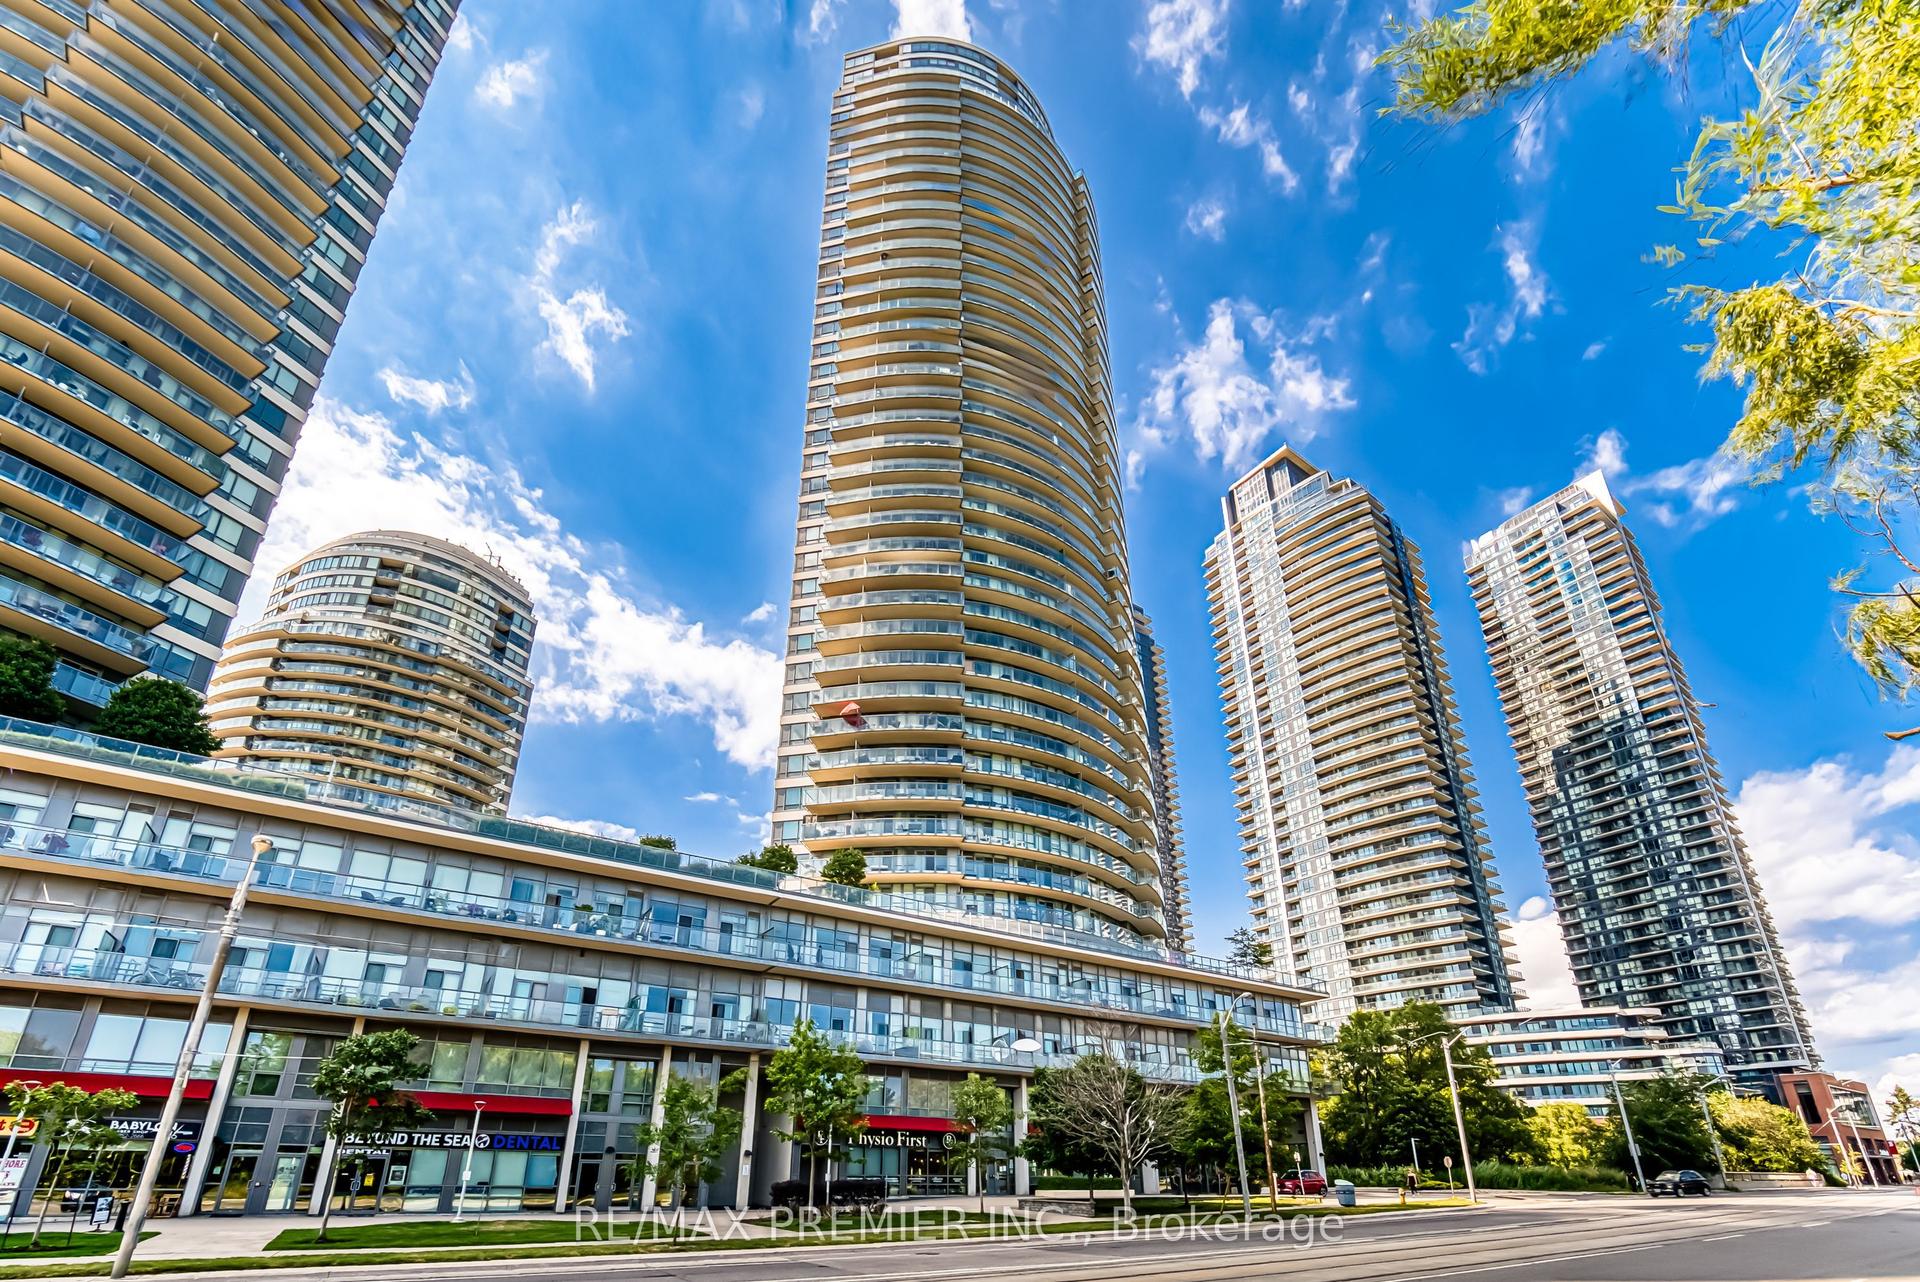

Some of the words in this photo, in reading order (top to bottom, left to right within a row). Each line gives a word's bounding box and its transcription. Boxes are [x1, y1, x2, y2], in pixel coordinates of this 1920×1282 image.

[110, 1120, 178, 1131] BABYLO
[412, 1133, 440, 1146] THE
[443, 1134, 472, 1147] SEA
[492, 1135, 561, 1150] DENTAL
[896, 1131, 927, 1147] First
